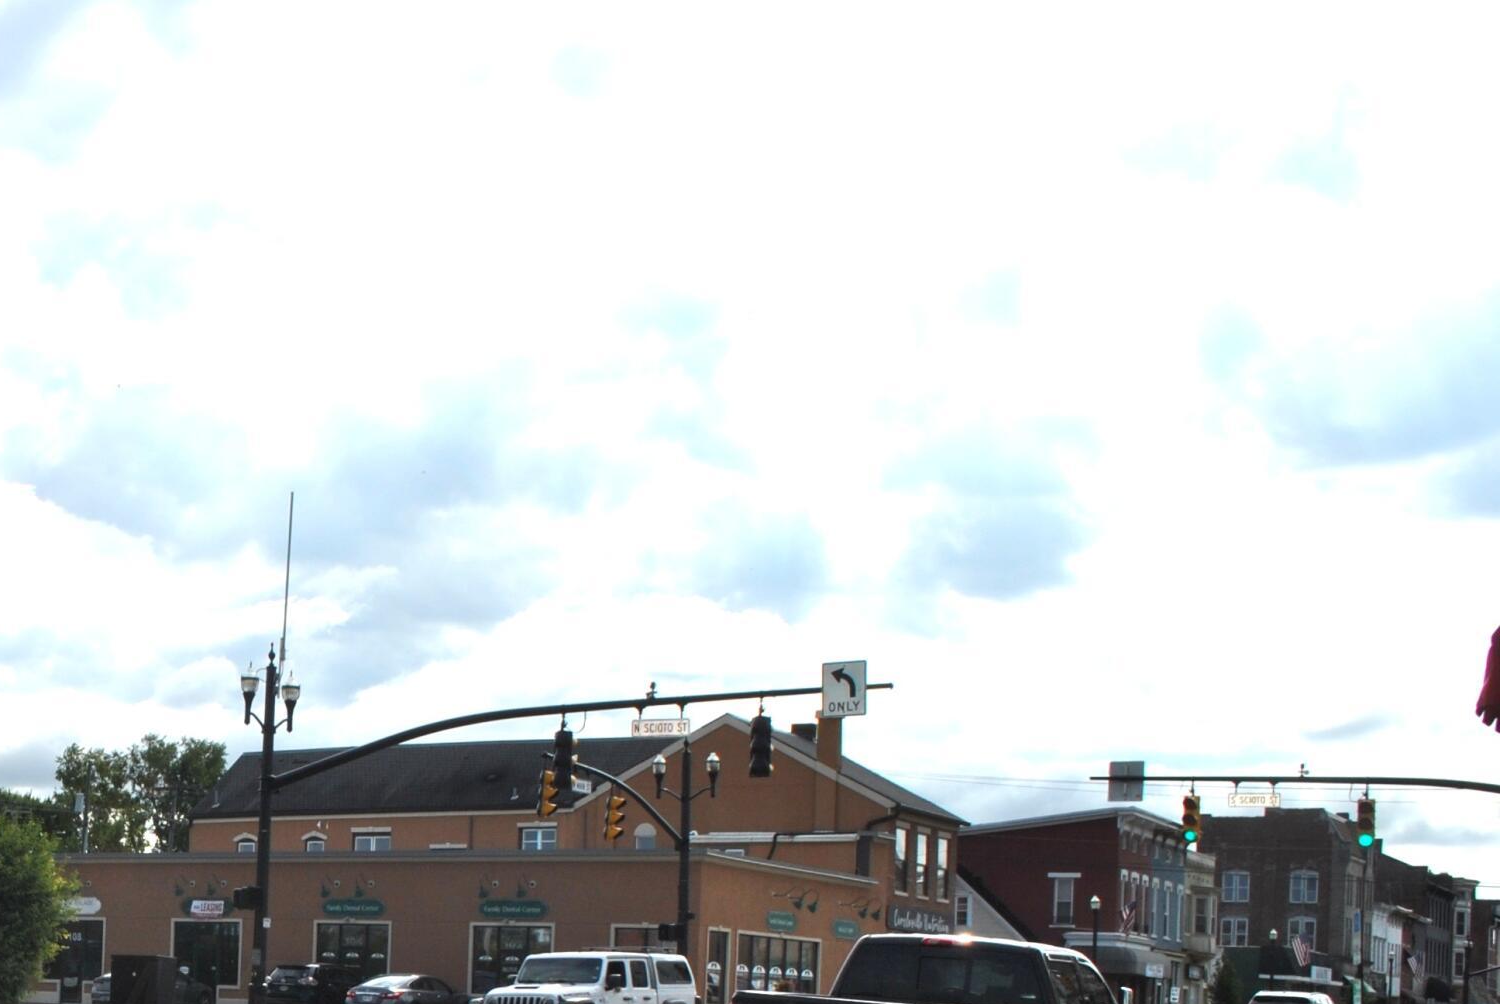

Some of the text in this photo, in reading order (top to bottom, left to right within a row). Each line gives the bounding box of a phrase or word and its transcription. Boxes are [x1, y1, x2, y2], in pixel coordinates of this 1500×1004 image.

[828, 700, 861, 713] ONLY
[634, 722, 688, 734] N SCIOTO ST
[1231, 796, 1278, 805] S SCIOTO ST
[201, 902, 223, 913] LEASING
